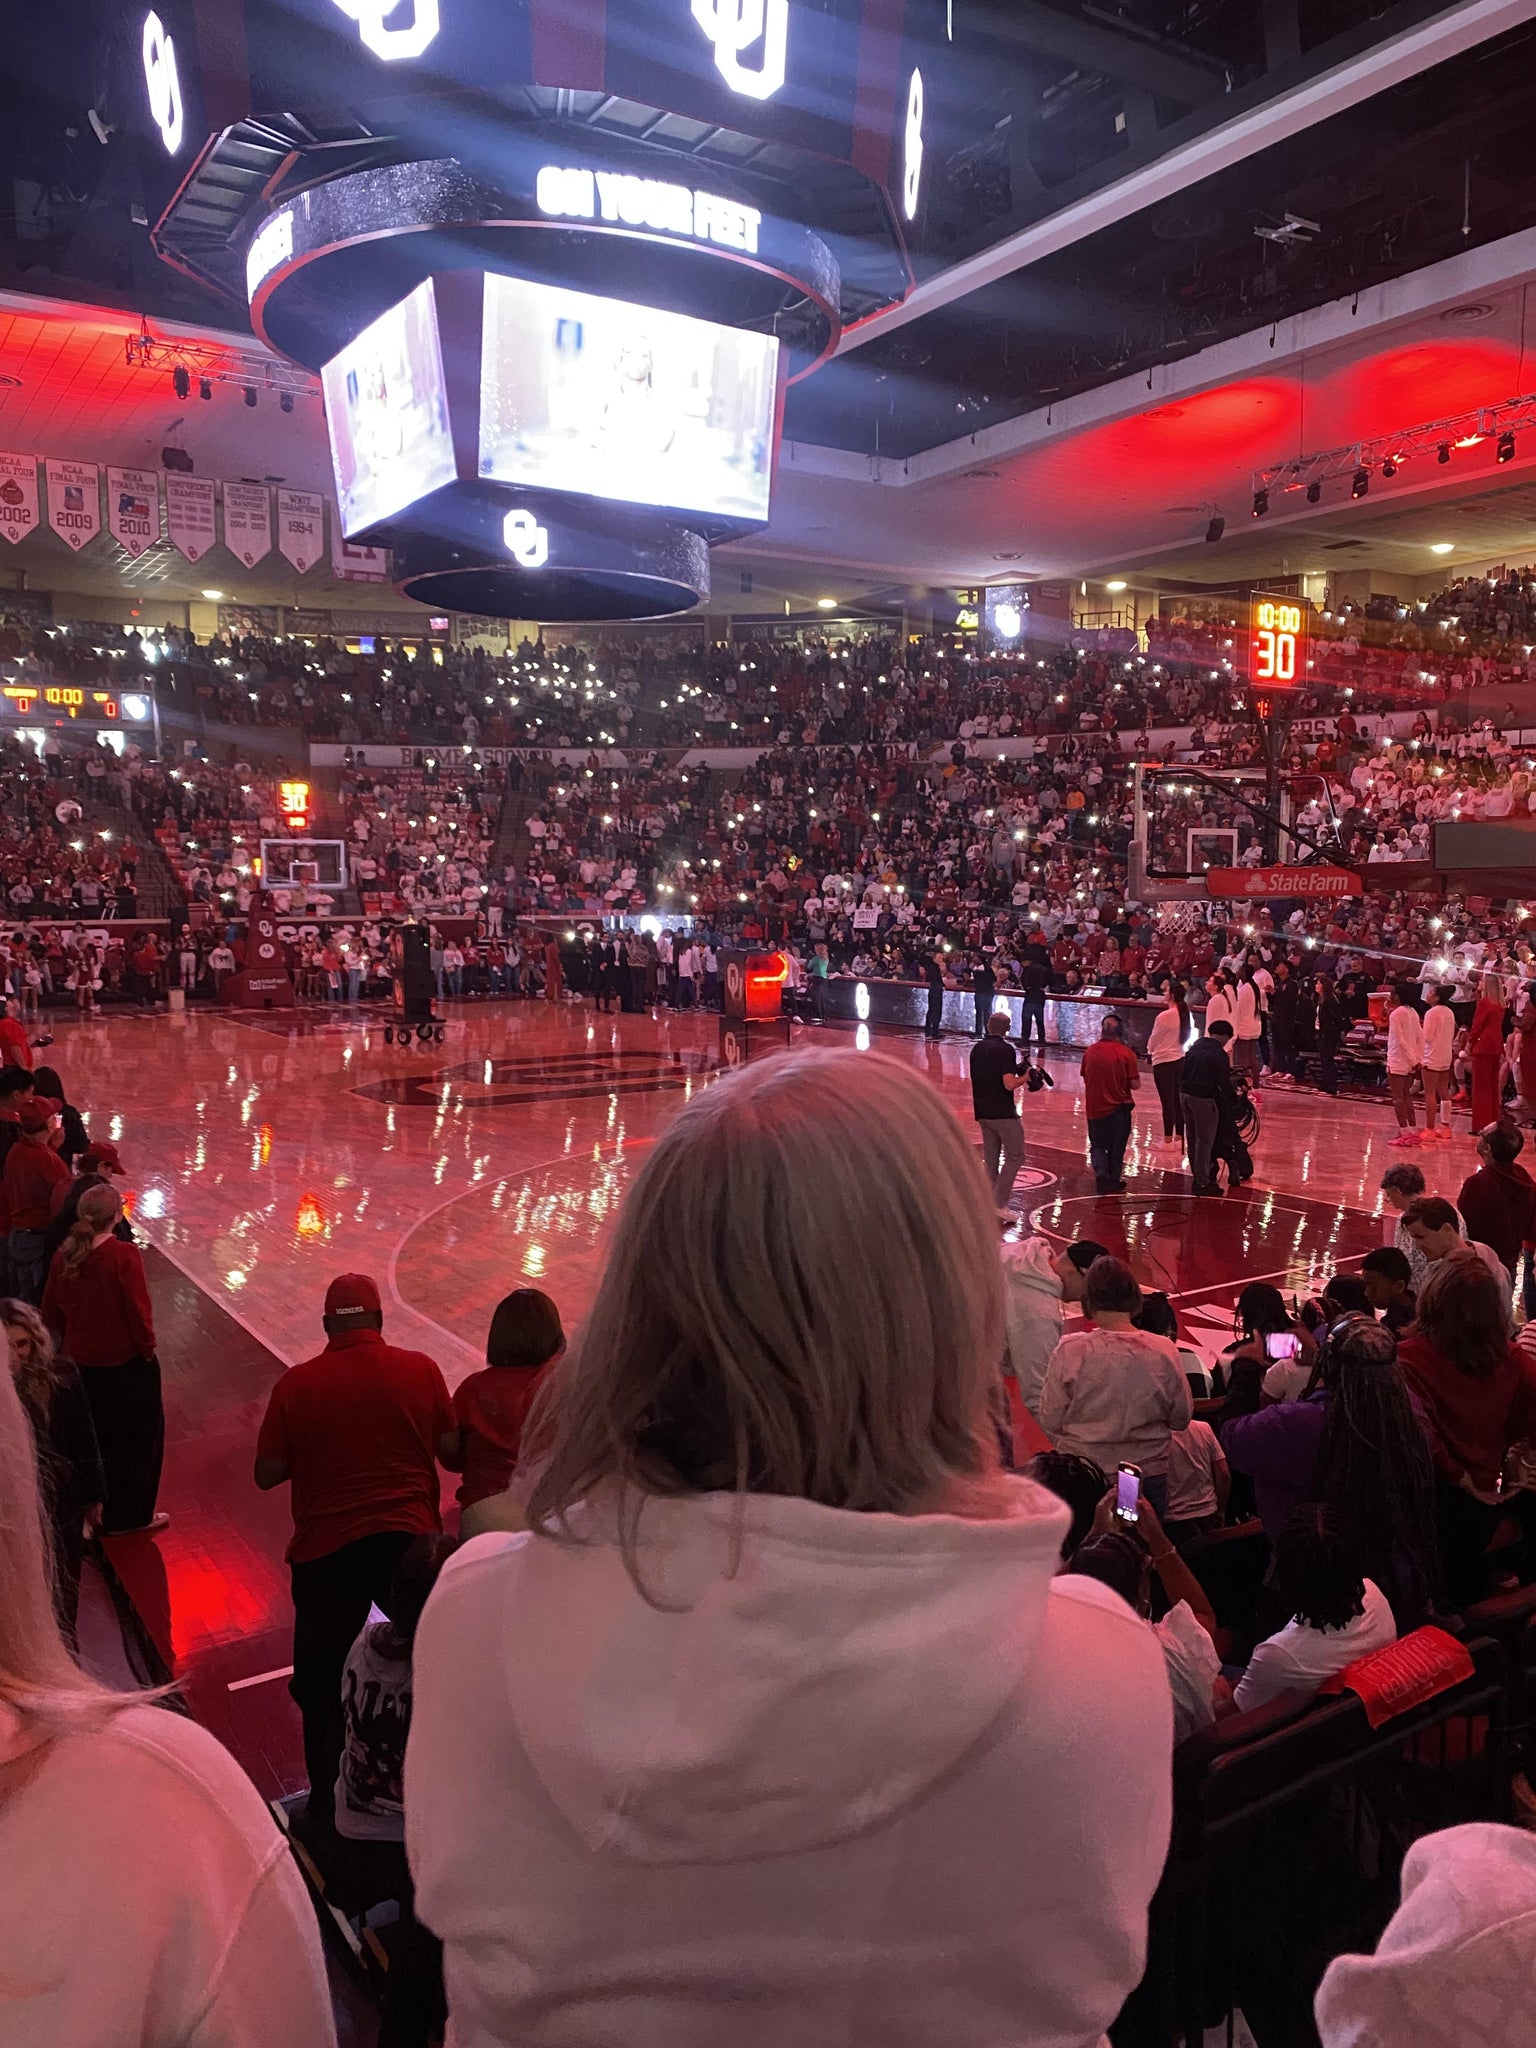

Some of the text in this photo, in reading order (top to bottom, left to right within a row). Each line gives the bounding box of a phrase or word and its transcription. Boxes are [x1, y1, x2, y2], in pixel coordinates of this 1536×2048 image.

[594, 171, 694, 235] YOUR
[693, 189, 762, 254] FEET
[62, 464, 83, 474] NCAA
[122, 472, 143, 481] NCAA
[50, 472, 97, 485] FINAL FOUR
[111, 479, 156, 493] FINAL FOUR
[56, 511, 93, 529] 2009
[119, 518, 151, 536] 2010
[288, 520, 315, 536] 1994
[503, 509, 548, 568] OU
[1258, 603, 1300, 633] 10:00
[1257, 631, 1296, 680] 30
[45, 687, 83, 705] 10:00
[19, 698, 29, 712] 0
[106, 702, 116, 717] 0
[258, 920, 273, 937] OU
